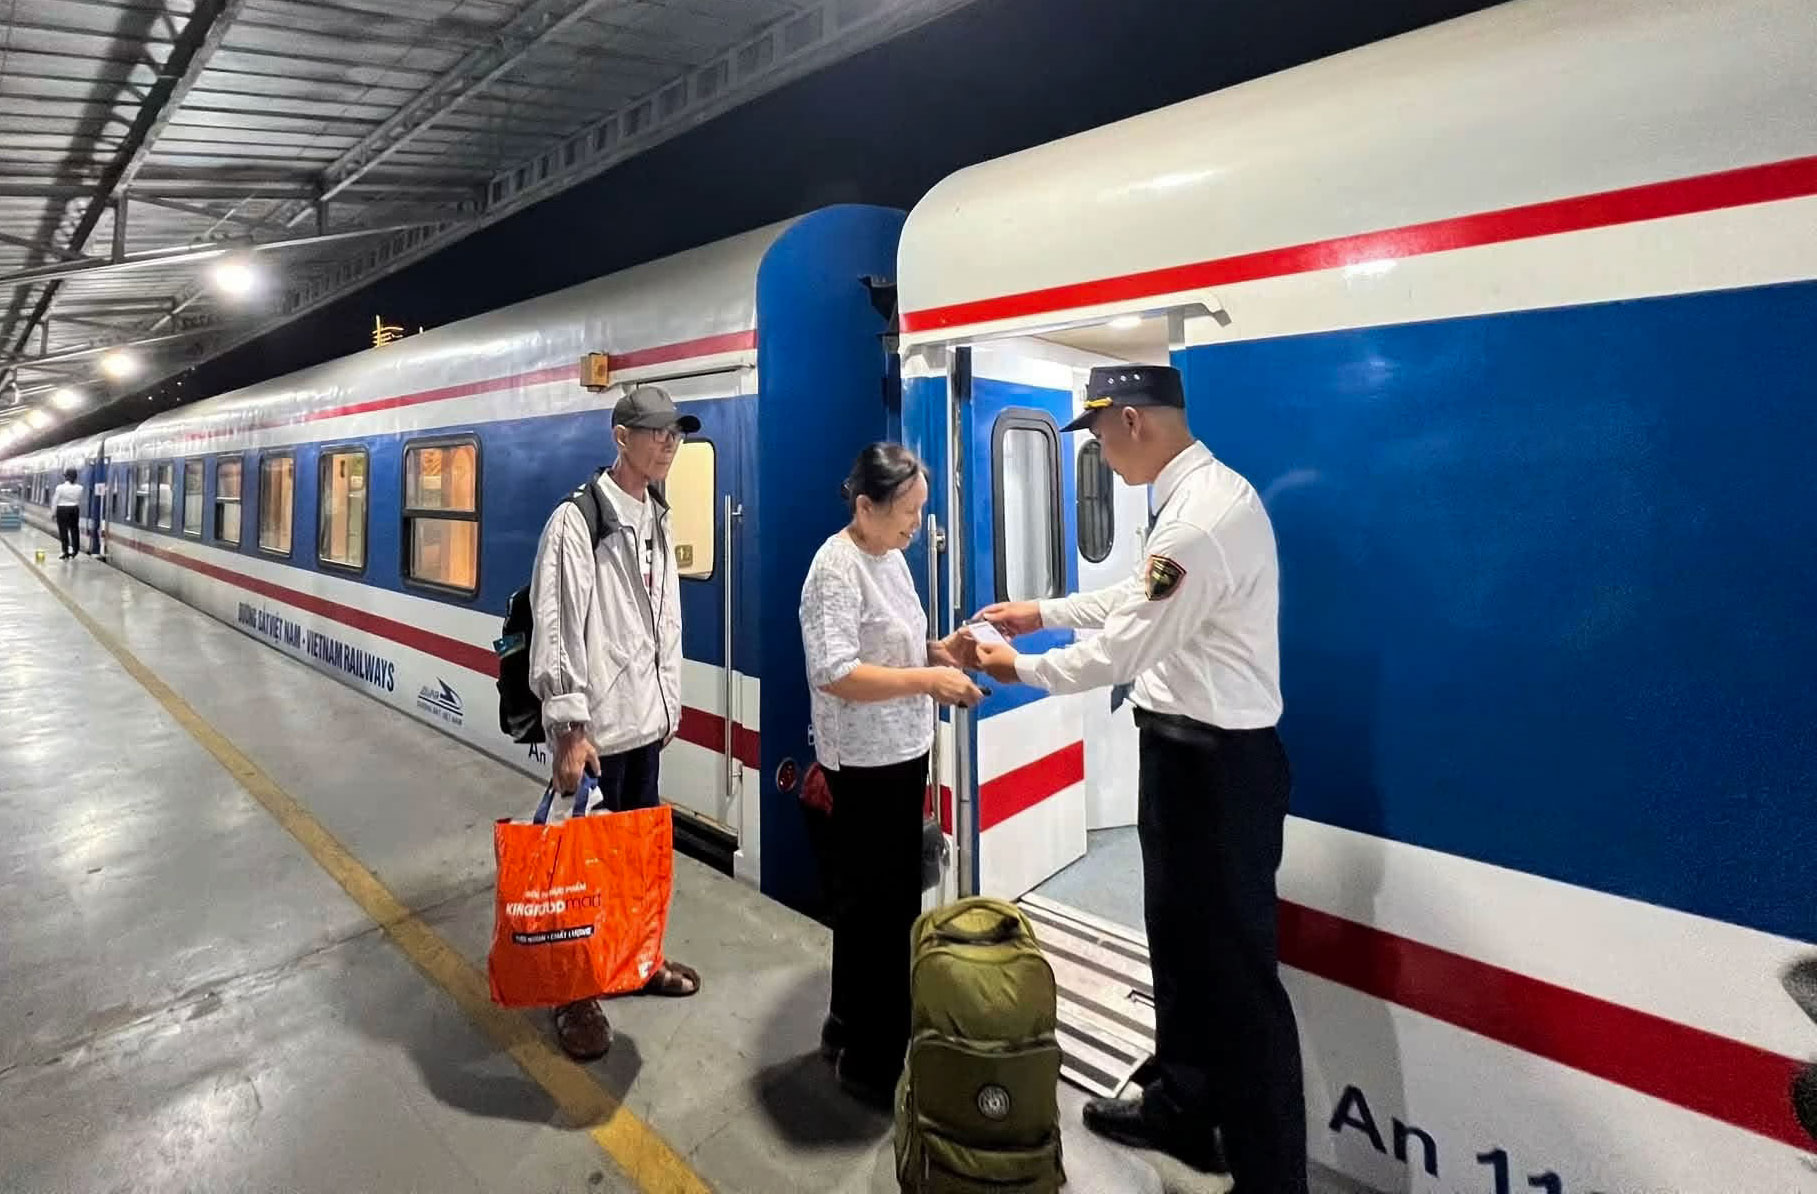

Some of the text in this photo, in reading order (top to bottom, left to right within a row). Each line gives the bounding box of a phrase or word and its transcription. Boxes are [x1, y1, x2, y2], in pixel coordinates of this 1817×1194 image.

[284, 619, 301, 649] NAM
[306, 629, 342, 669] VIETNAM
[343, 643, 395, 692] RAILWAYS
[528, 742, 546, 765] An
[1329, 1084, 1438, 1178] An
